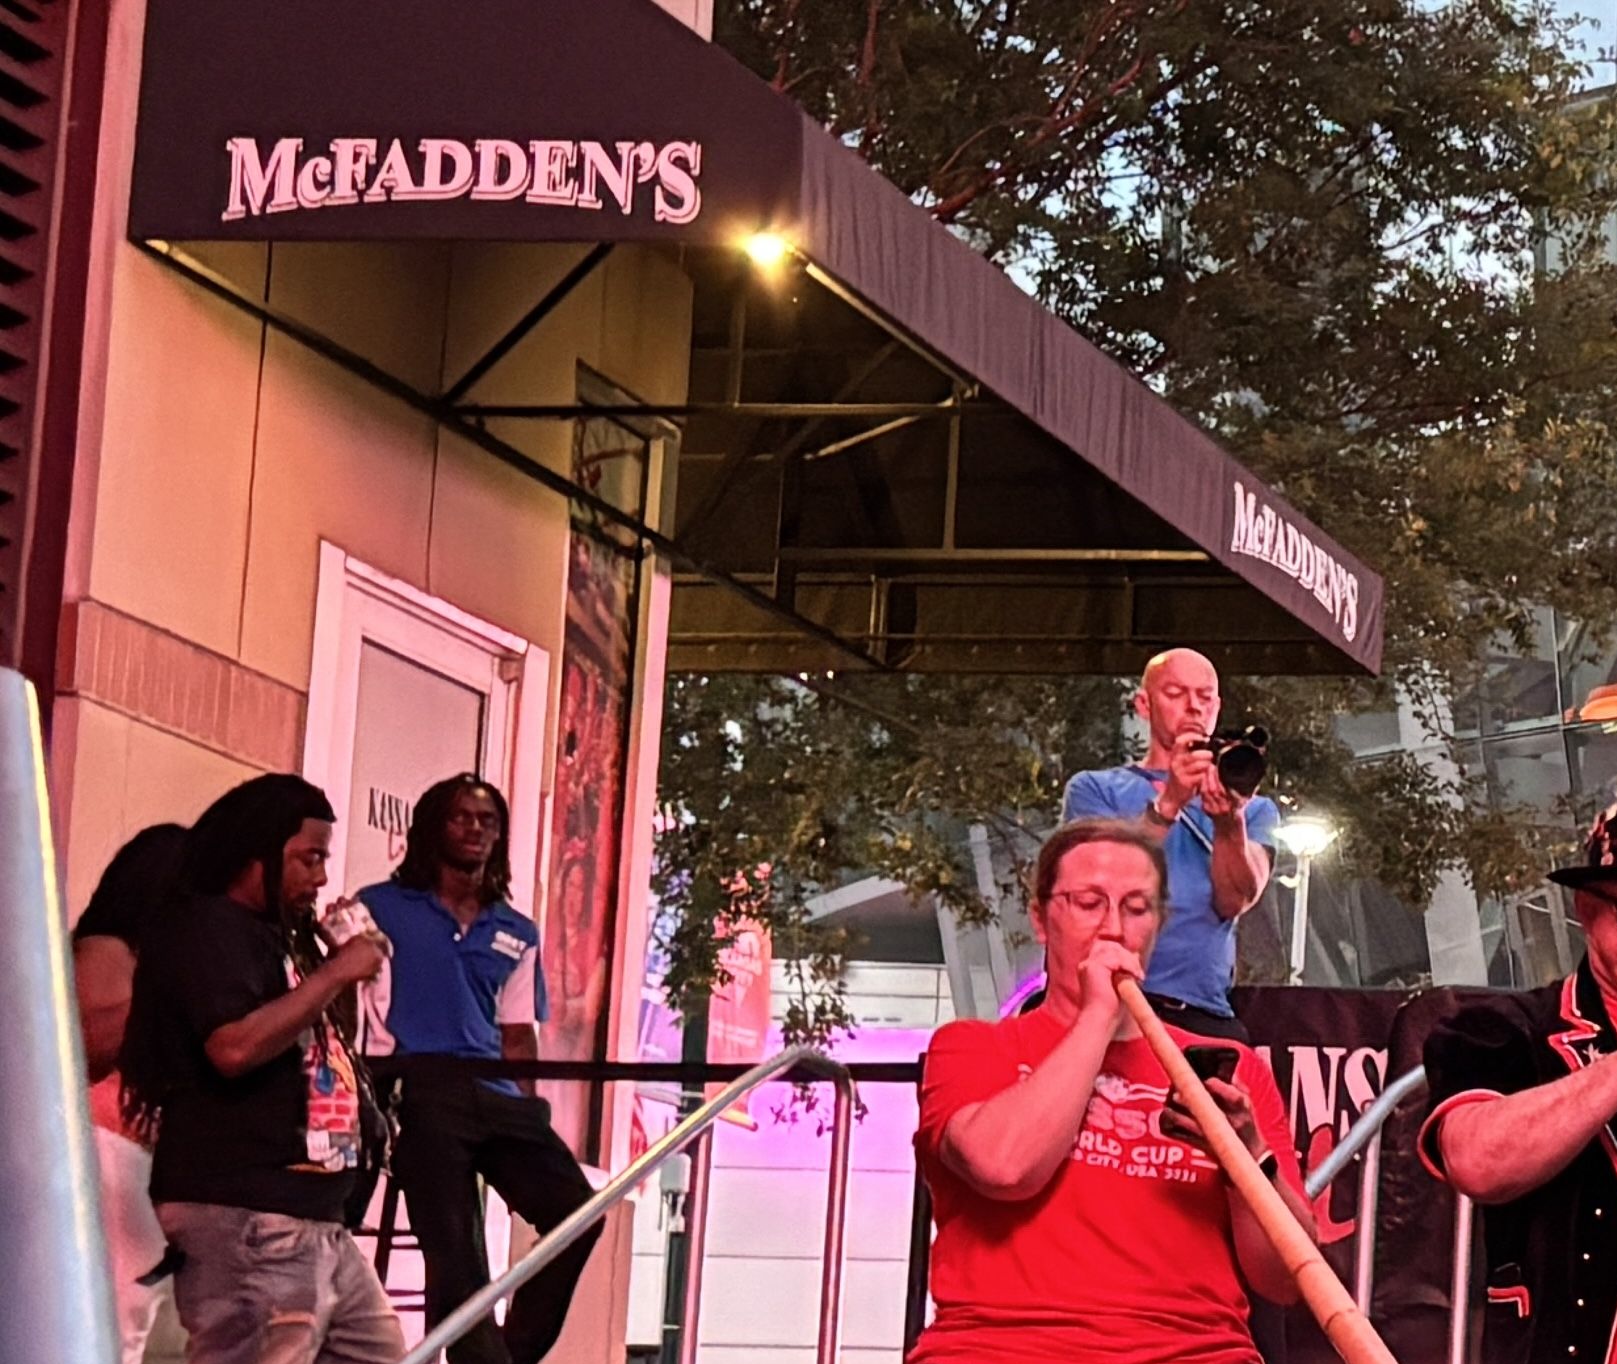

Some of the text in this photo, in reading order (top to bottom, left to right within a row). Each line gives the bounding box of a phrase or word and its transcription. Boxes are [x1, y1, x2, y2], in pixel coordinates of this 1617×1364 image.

[222, 137, 702, 224] McFADDEN'S
[1231, 481, 1359, 642] McFADDEN'S
[1074, 1130, 1122, 1156] RLD
[1131, 1146, 1184, 1165] CUP
